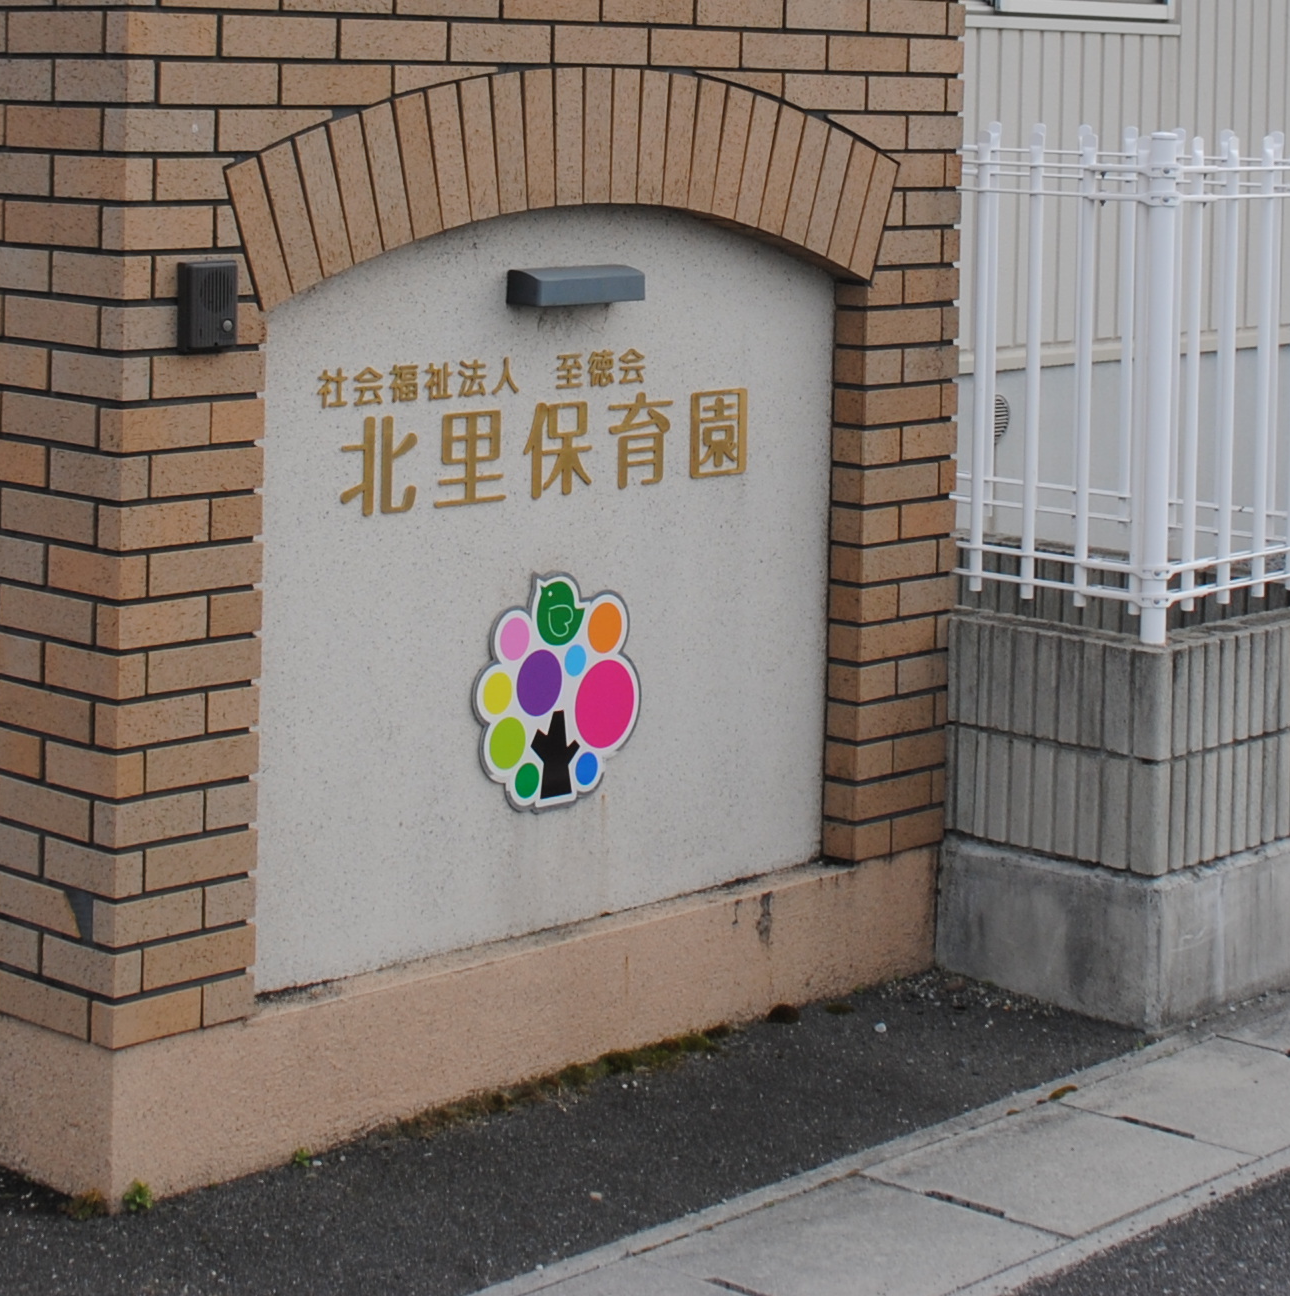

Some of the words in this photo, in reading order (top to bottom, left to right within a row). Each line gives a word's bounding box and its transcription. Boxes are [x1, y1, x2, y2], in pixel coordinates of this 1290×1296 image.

[317, 356, 520, 409] 社会福祉法人
[555, 348, 646, 390] 至徳会
[340, 388, 748, 517] 北里保育園
